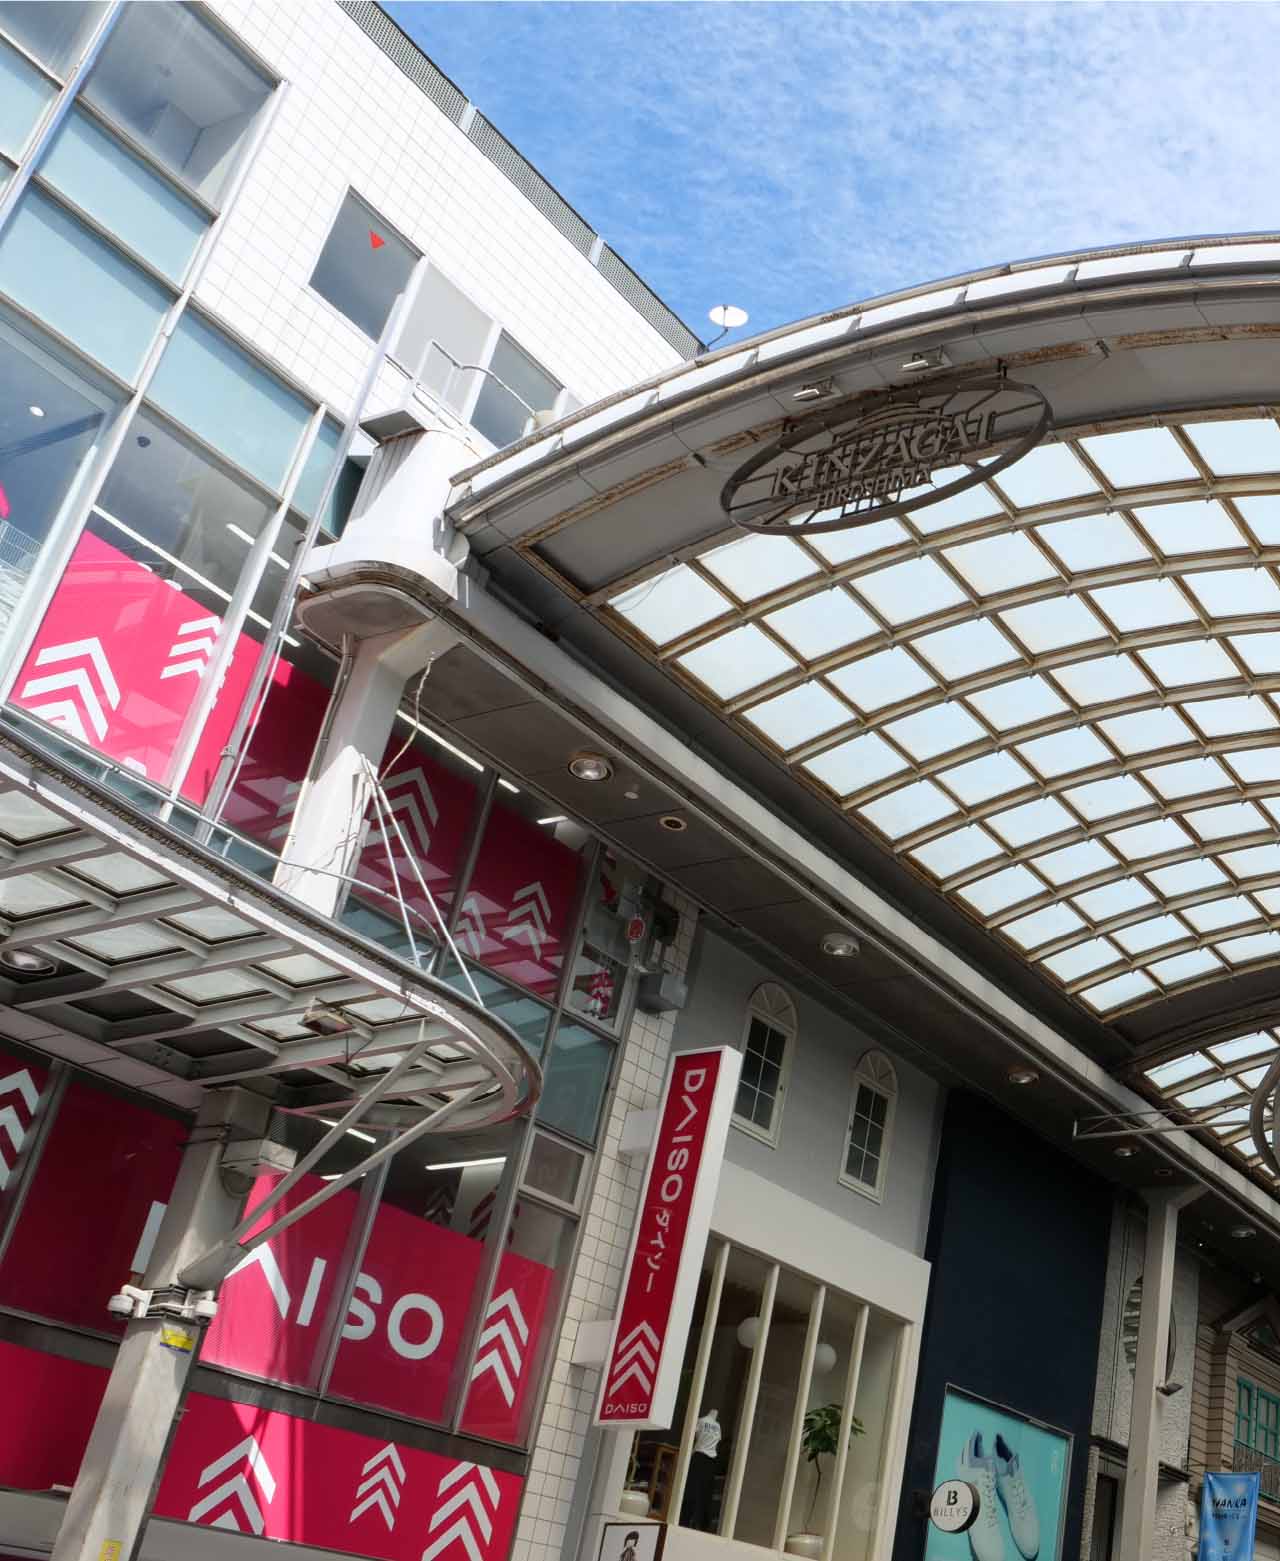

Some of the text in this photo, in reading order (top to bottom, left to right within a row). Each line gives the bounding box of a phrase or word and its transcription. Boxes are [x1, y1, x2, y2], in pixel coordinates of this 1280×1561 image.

[771, 410, 998, 497] KINZAGAI
[814, 466, 932, 508] HIROSHIMA
[660, 1068, 707, 1203] DAISO
[646, 1207, 671, 1294] ダイソー
[604, 1402, 649, 1416] DAISO
